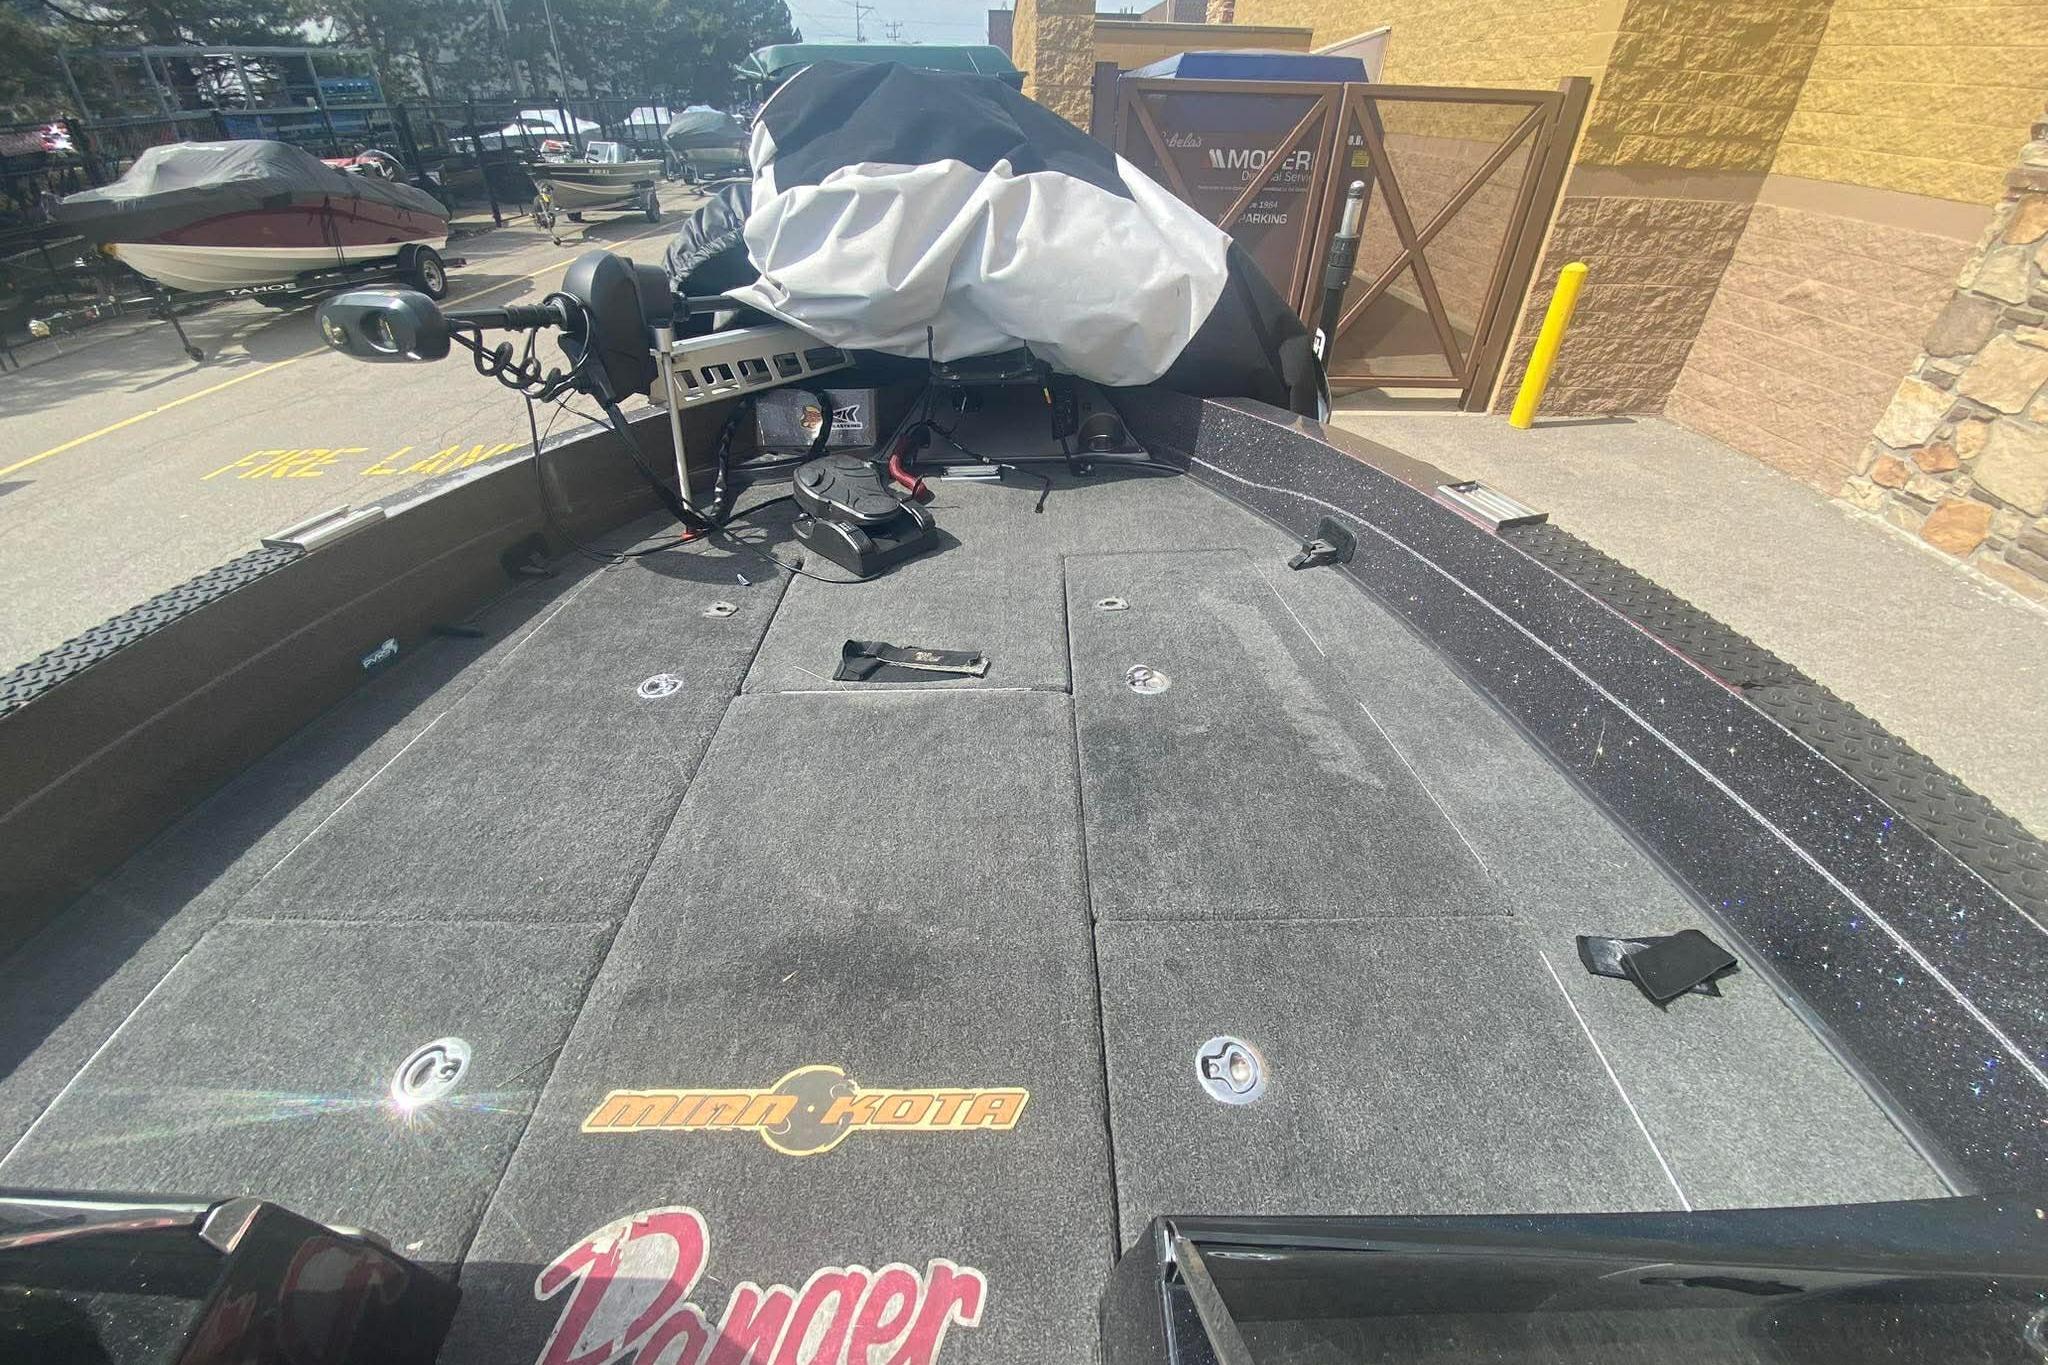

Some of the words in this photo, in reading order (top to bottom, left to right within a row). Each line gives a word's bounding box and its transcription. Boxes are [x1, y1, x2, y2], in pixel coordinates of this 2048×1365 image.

[225, 282, 297, 296] TAHOE
[200, 447, 368, 480] FIRE
[360, 444, 518, 475] LAN
[820, 1090, 1027, 1129] KOTA
